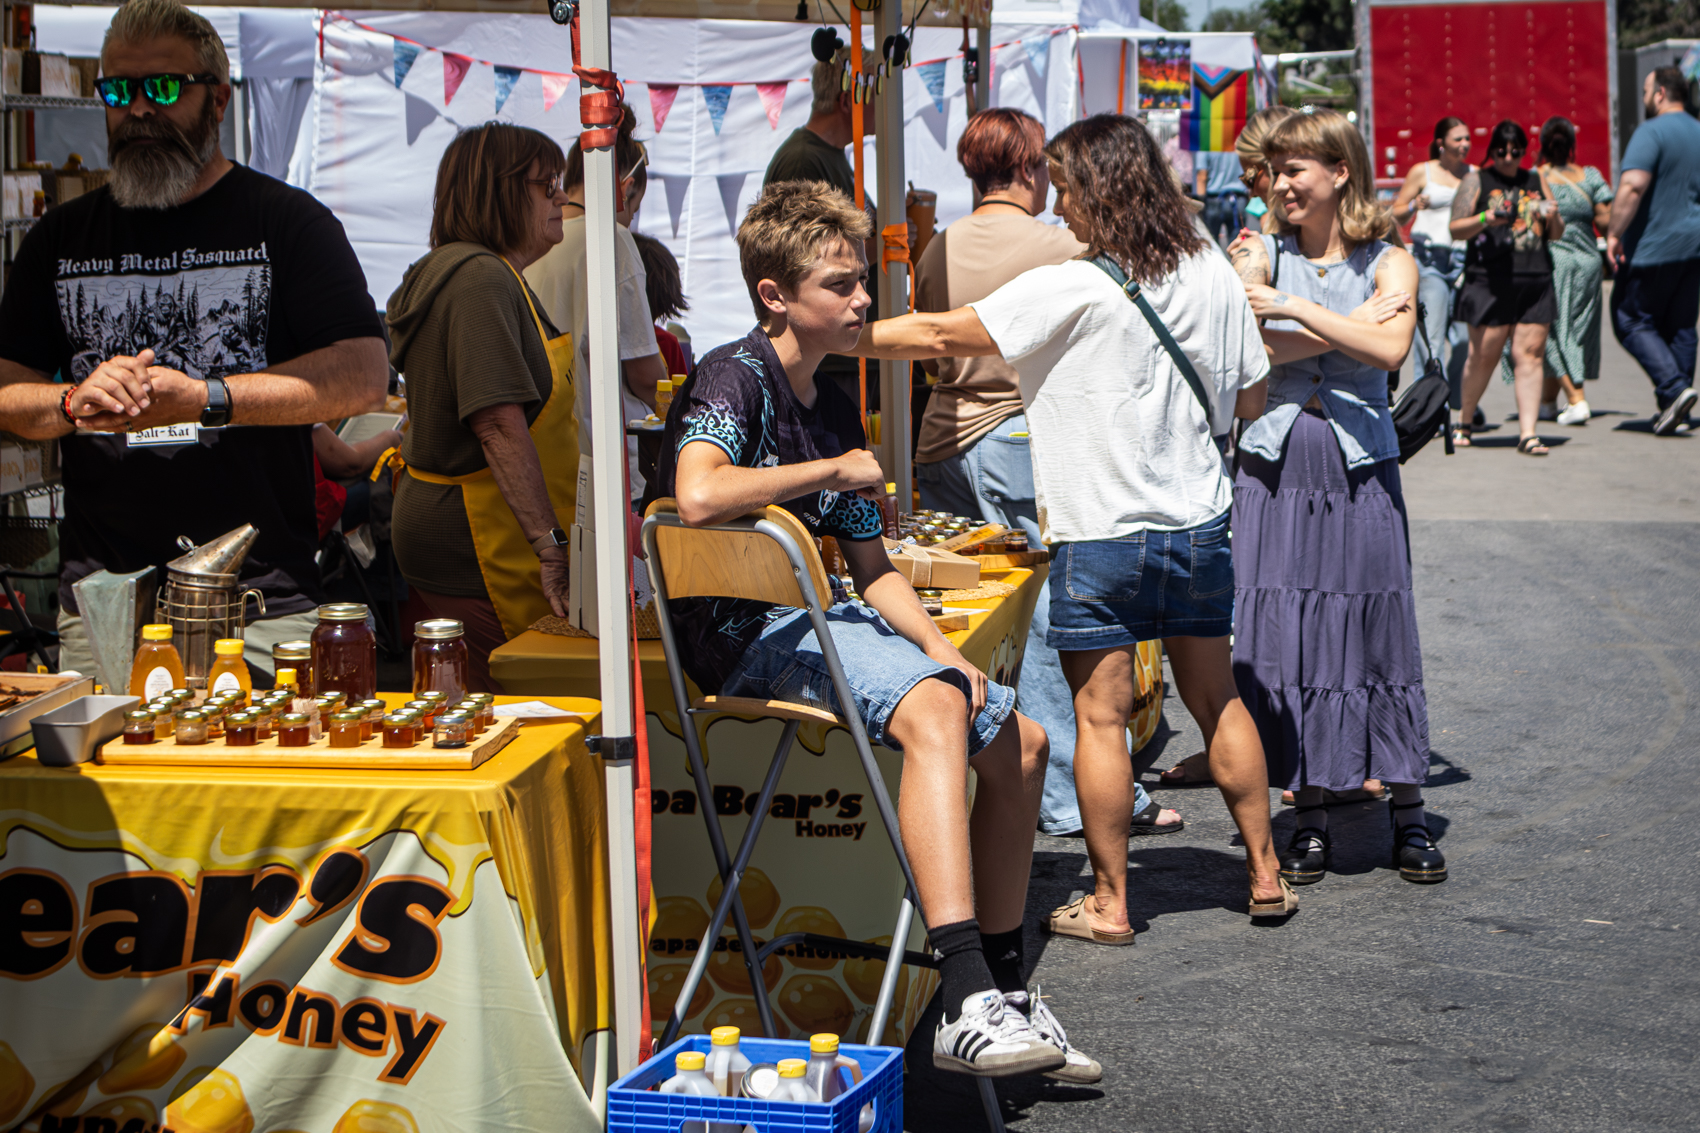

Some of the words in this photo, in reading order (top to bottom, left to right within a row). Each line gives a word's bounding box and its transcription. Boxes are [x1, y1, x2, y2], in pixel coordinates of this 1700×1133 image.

[57, 257, 114, 277] Heavy
[120, 250, 178, 274] Metal
[795, 820, 868, 841] Honey
[649, 938, 699, 954] apa
[167, 970, 447, 1085] Honey
